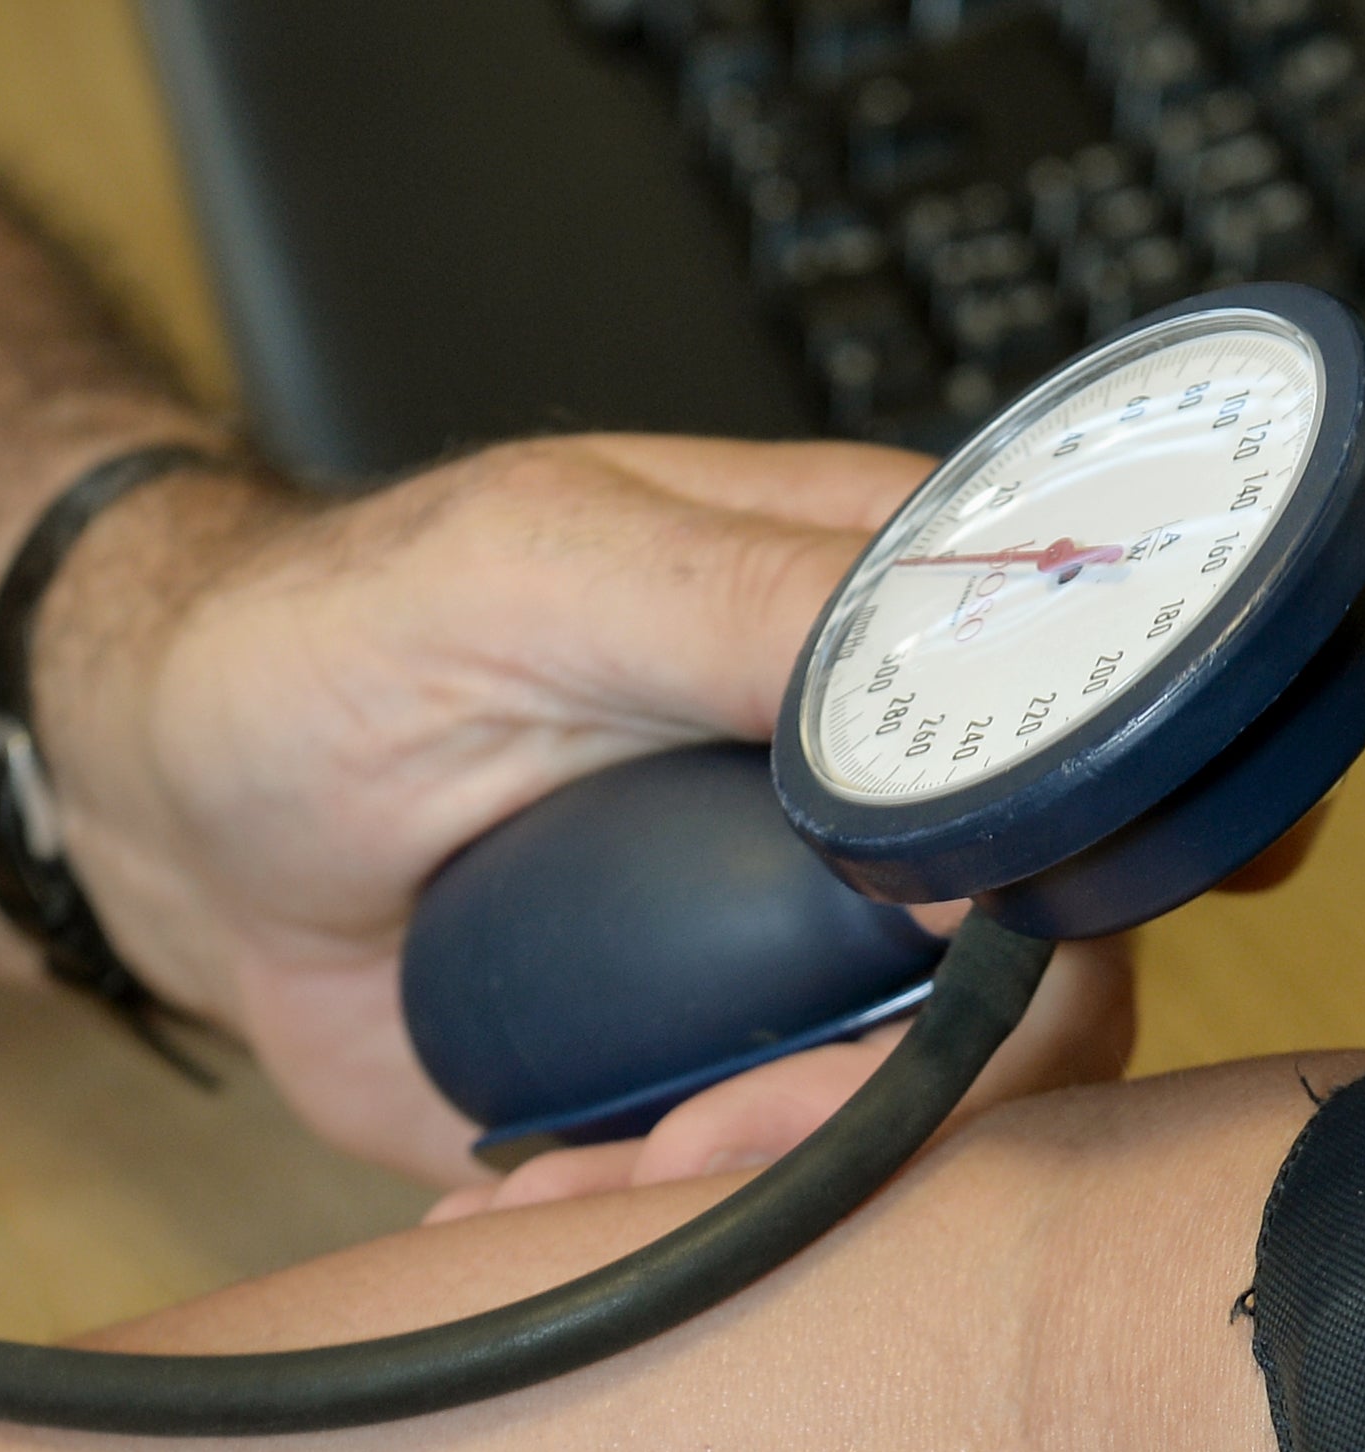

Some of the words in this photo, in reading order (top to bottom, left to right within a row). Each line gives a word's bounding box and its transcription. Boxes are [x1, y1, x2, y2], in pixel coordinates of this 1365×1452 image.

[1118, 395, 1152, 422] 60
[1177, 379, 1212, 410] 80
[1212, 388, 1251, 429] 100
[1052, 432, 1086, 458] 40
[1232, 419, 1272, 461] 120
[987, 480, 1022, 508] 20
[1229, 469, 1270, 512] 140
[1200, 530, 1241, 574] 160
[1146, 597, 1185, 640] 180
[1081, 650, 1125, 696] 200
[874, 691, 917, 736] 280
[904, 712, 947, 758] 260
[1015, 691, 1058, 738] 220
[951, 714, 995, 761] 240
